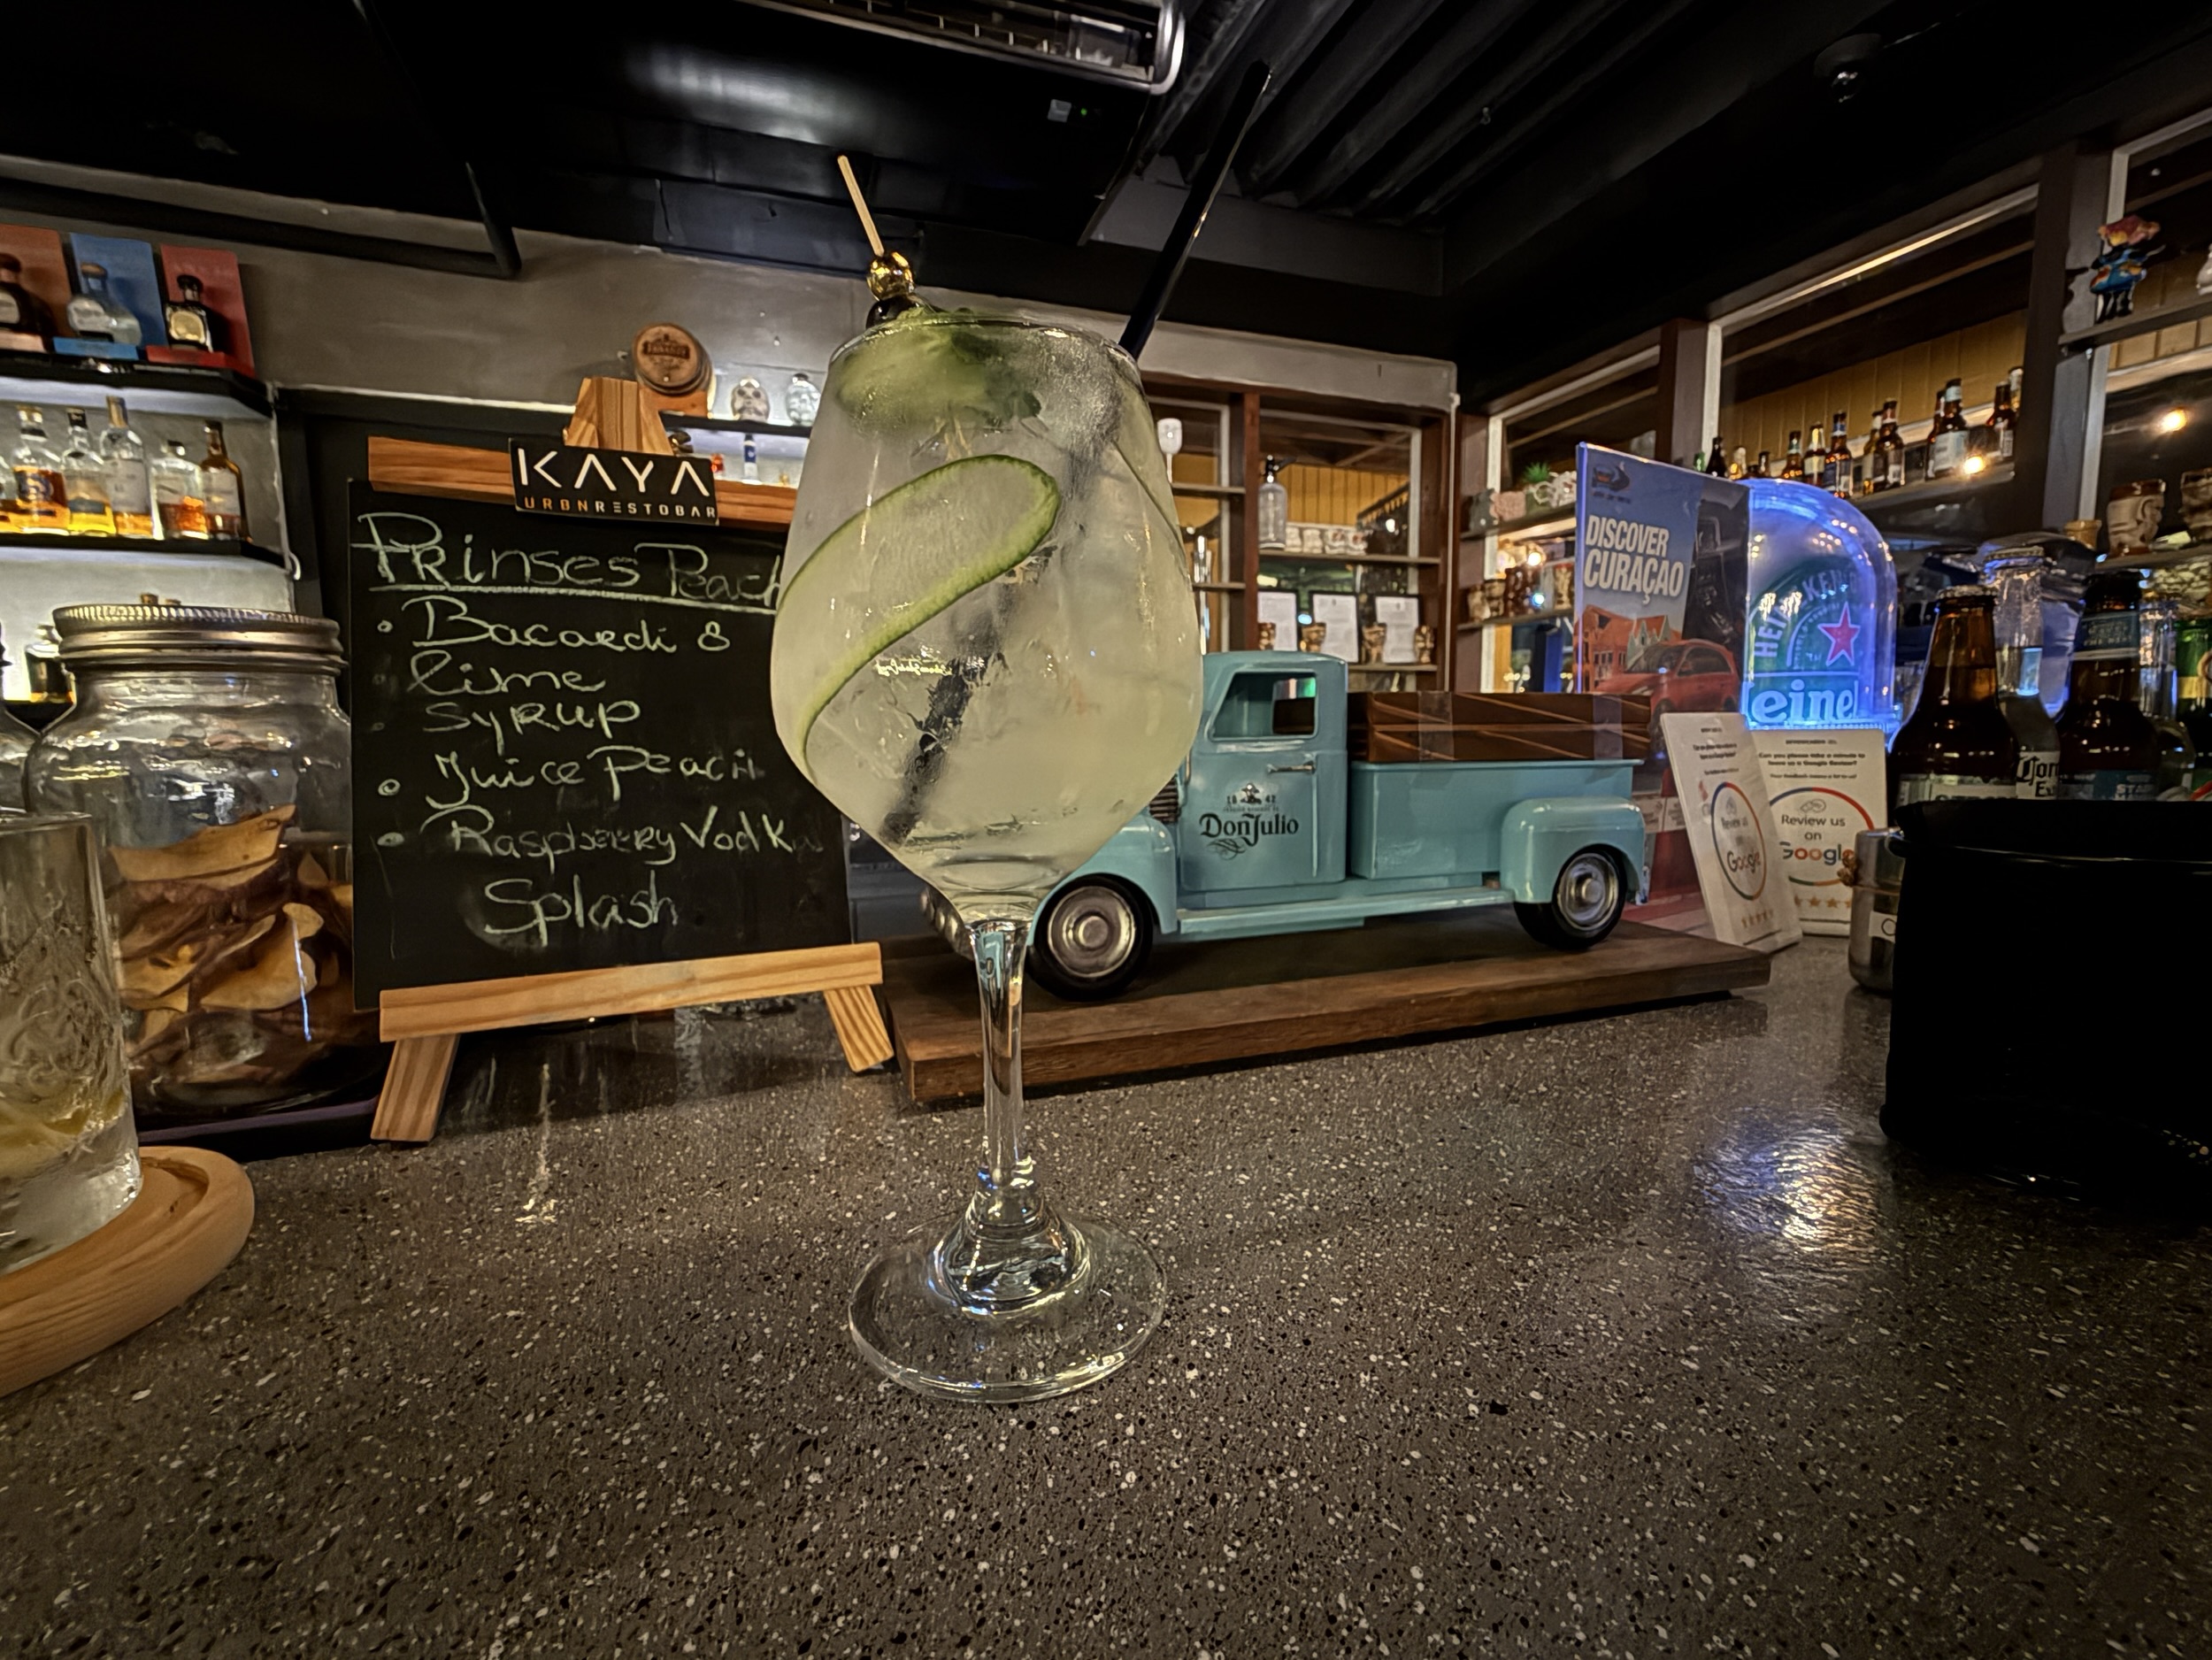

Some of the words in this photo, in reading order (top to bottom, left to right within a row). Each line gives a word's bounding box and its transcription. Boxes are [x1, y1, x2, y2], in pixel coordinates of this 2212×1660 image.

[517, 448, 710, 497] KAYA
[1585, 515, 1670, 558] DISCOVER
[1584, 549, 1685, 606] CURAÇAO
[1780, 813, 1826, 826] Review
[1830, 814, 1847, 827] us
[1804, 831, 1823, 841] on
[482, 868, 679, 948] Splash
